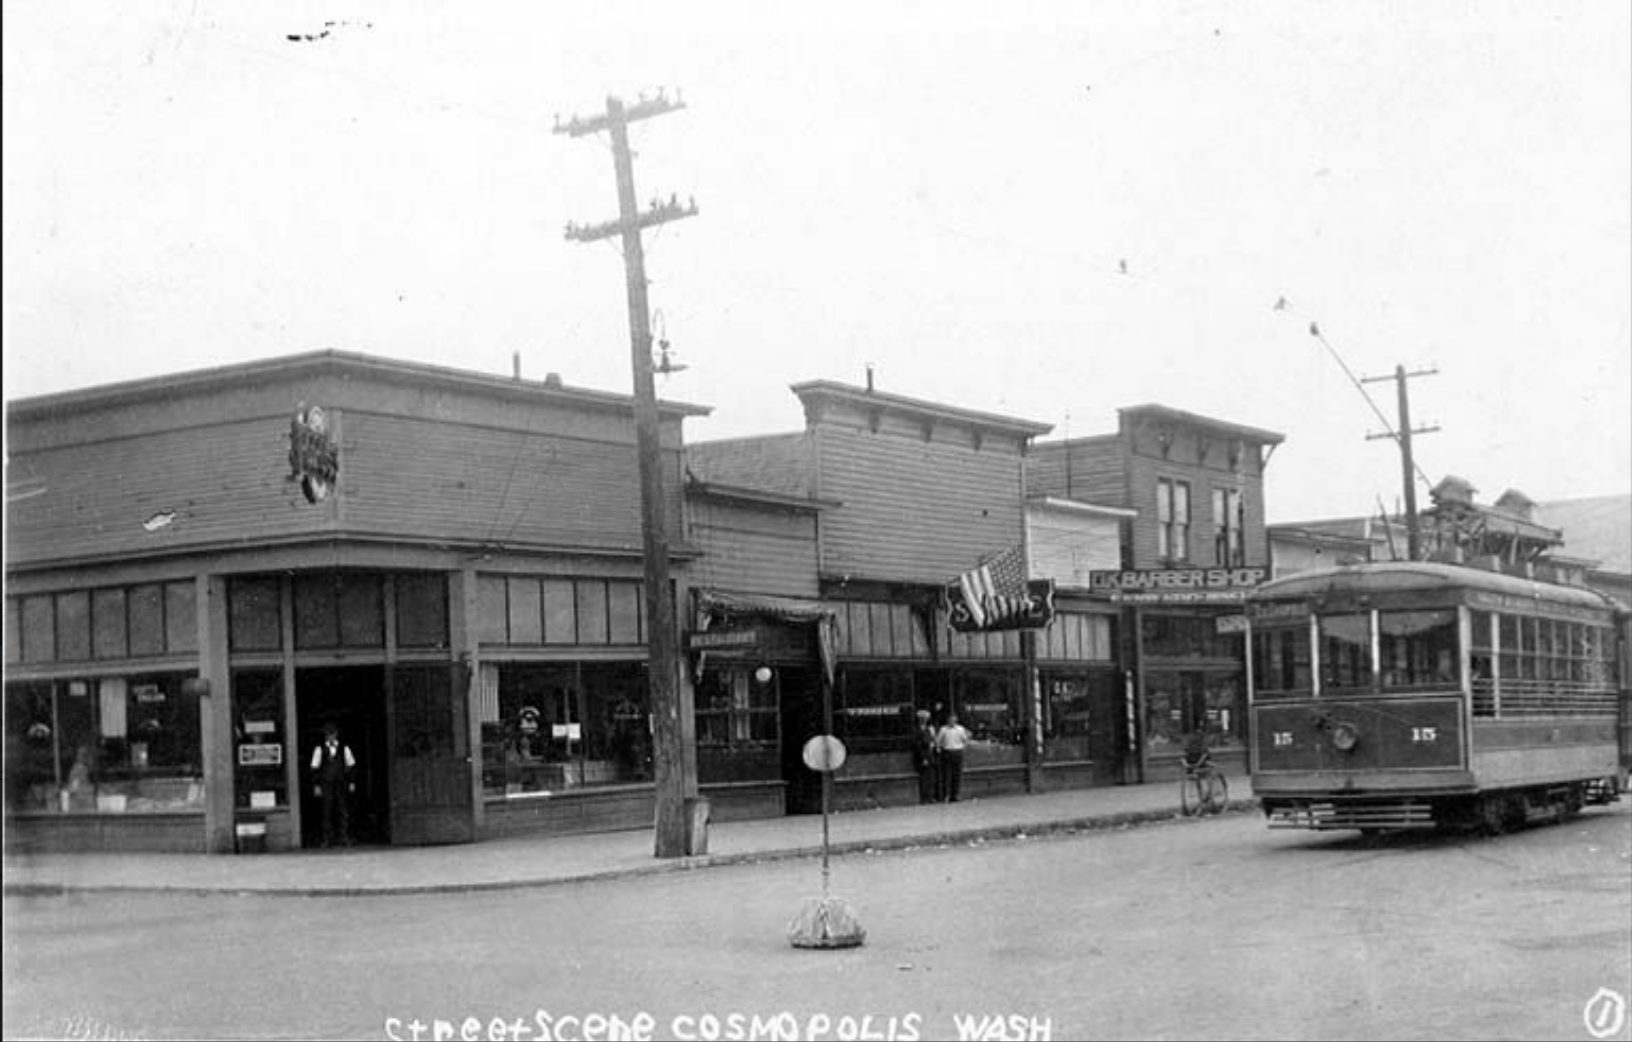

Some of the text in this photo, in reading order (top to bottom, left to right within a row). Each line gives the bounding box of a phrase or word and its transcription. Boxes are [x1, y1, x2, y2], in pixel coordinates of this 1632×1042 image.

[1123, 570, 1204, 588] BARBER
[1207, 569, 1265, 587] SHOP
[1273, 731, 1294, 746] 15
[1411, 726, 1438, 742] 15
